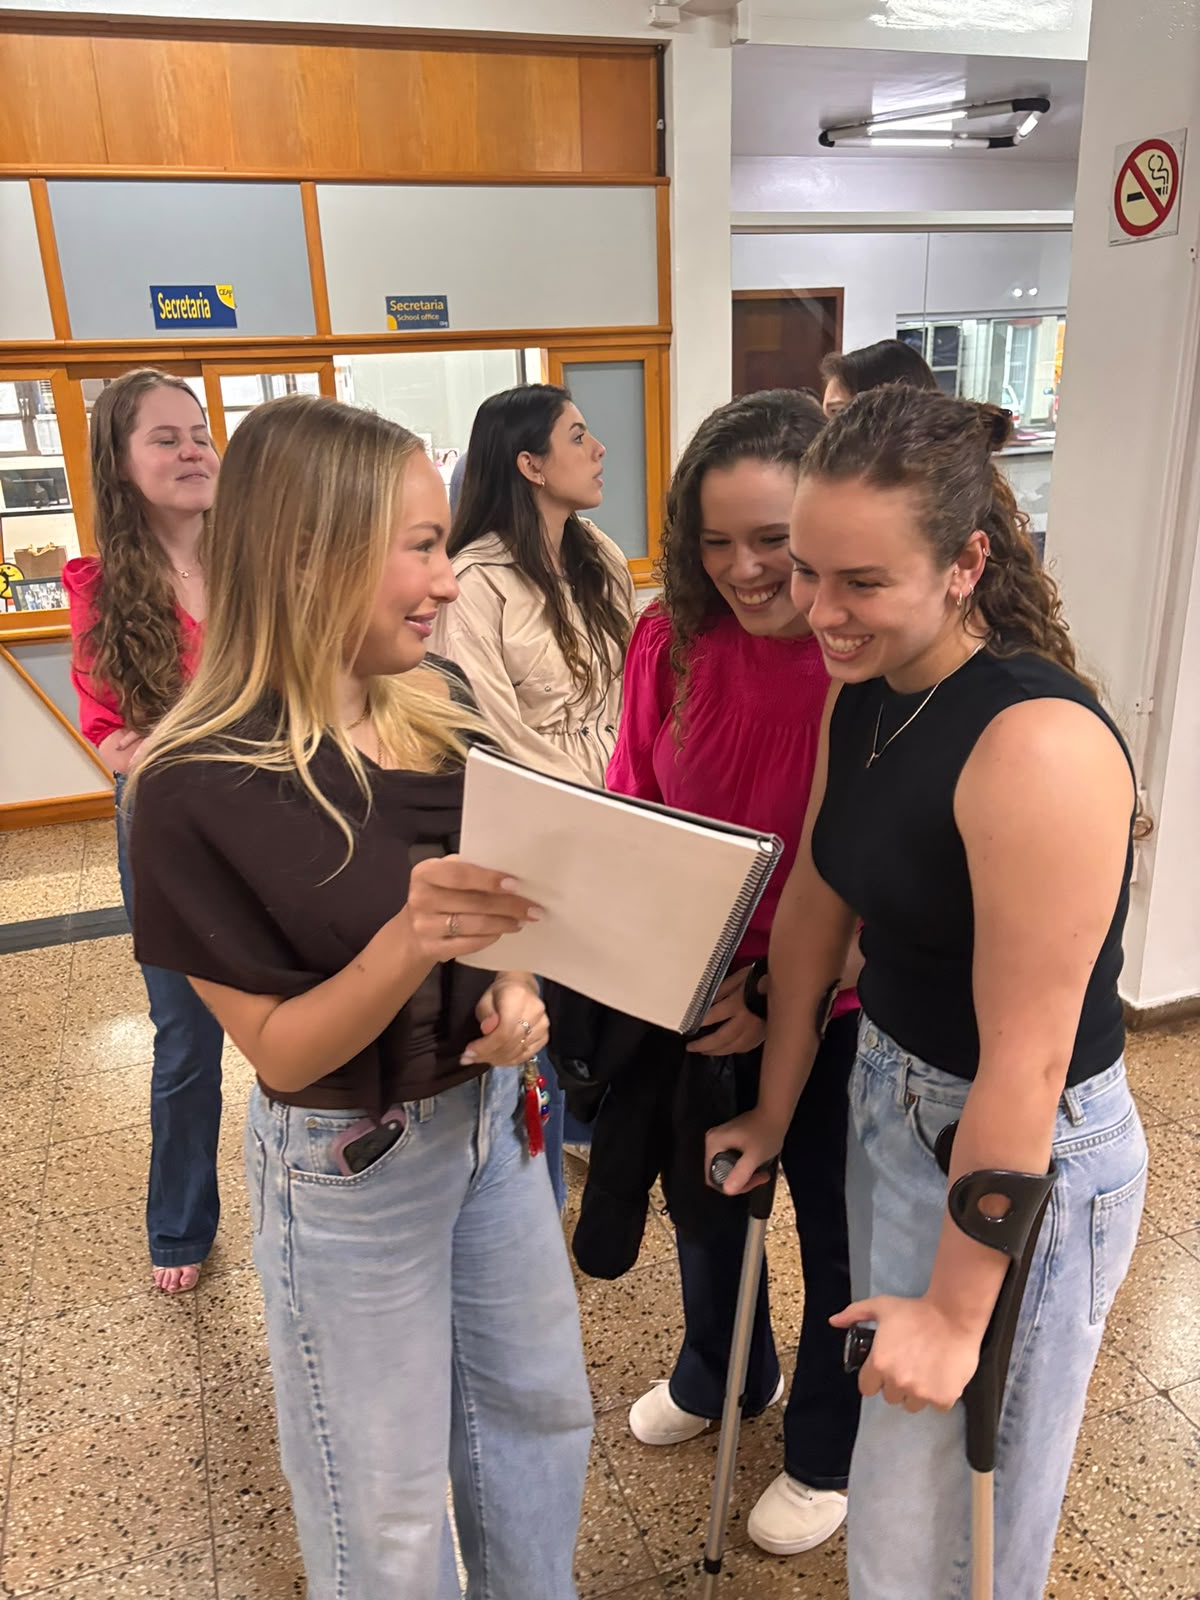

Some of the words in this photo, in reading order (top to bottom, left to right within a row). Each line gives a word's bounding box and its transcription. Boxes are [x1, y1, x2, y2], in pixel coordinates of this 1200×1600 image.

[157, 291, 212, 319] Secretaria
[390, 299, 444, 311] Secretaria
[397, 313, 420, 321] School
